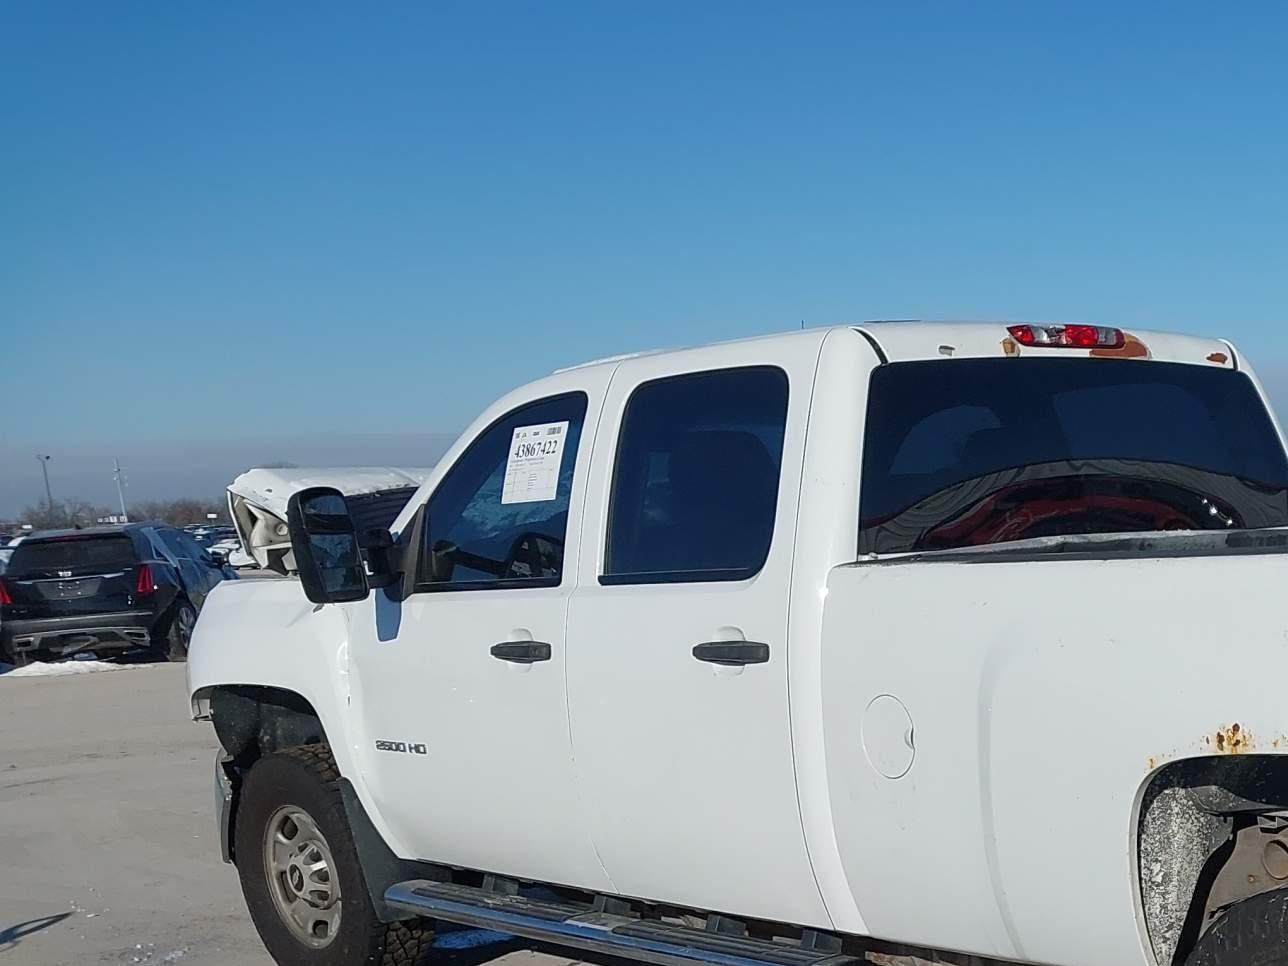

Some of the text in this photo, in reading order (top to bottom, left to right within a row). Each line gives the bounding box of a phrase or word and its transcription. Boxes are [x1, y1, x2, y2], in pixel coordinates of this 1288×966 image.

[514, 440, 557, 458] 43867422
[376, 740, 427, 754] 2500 HD
